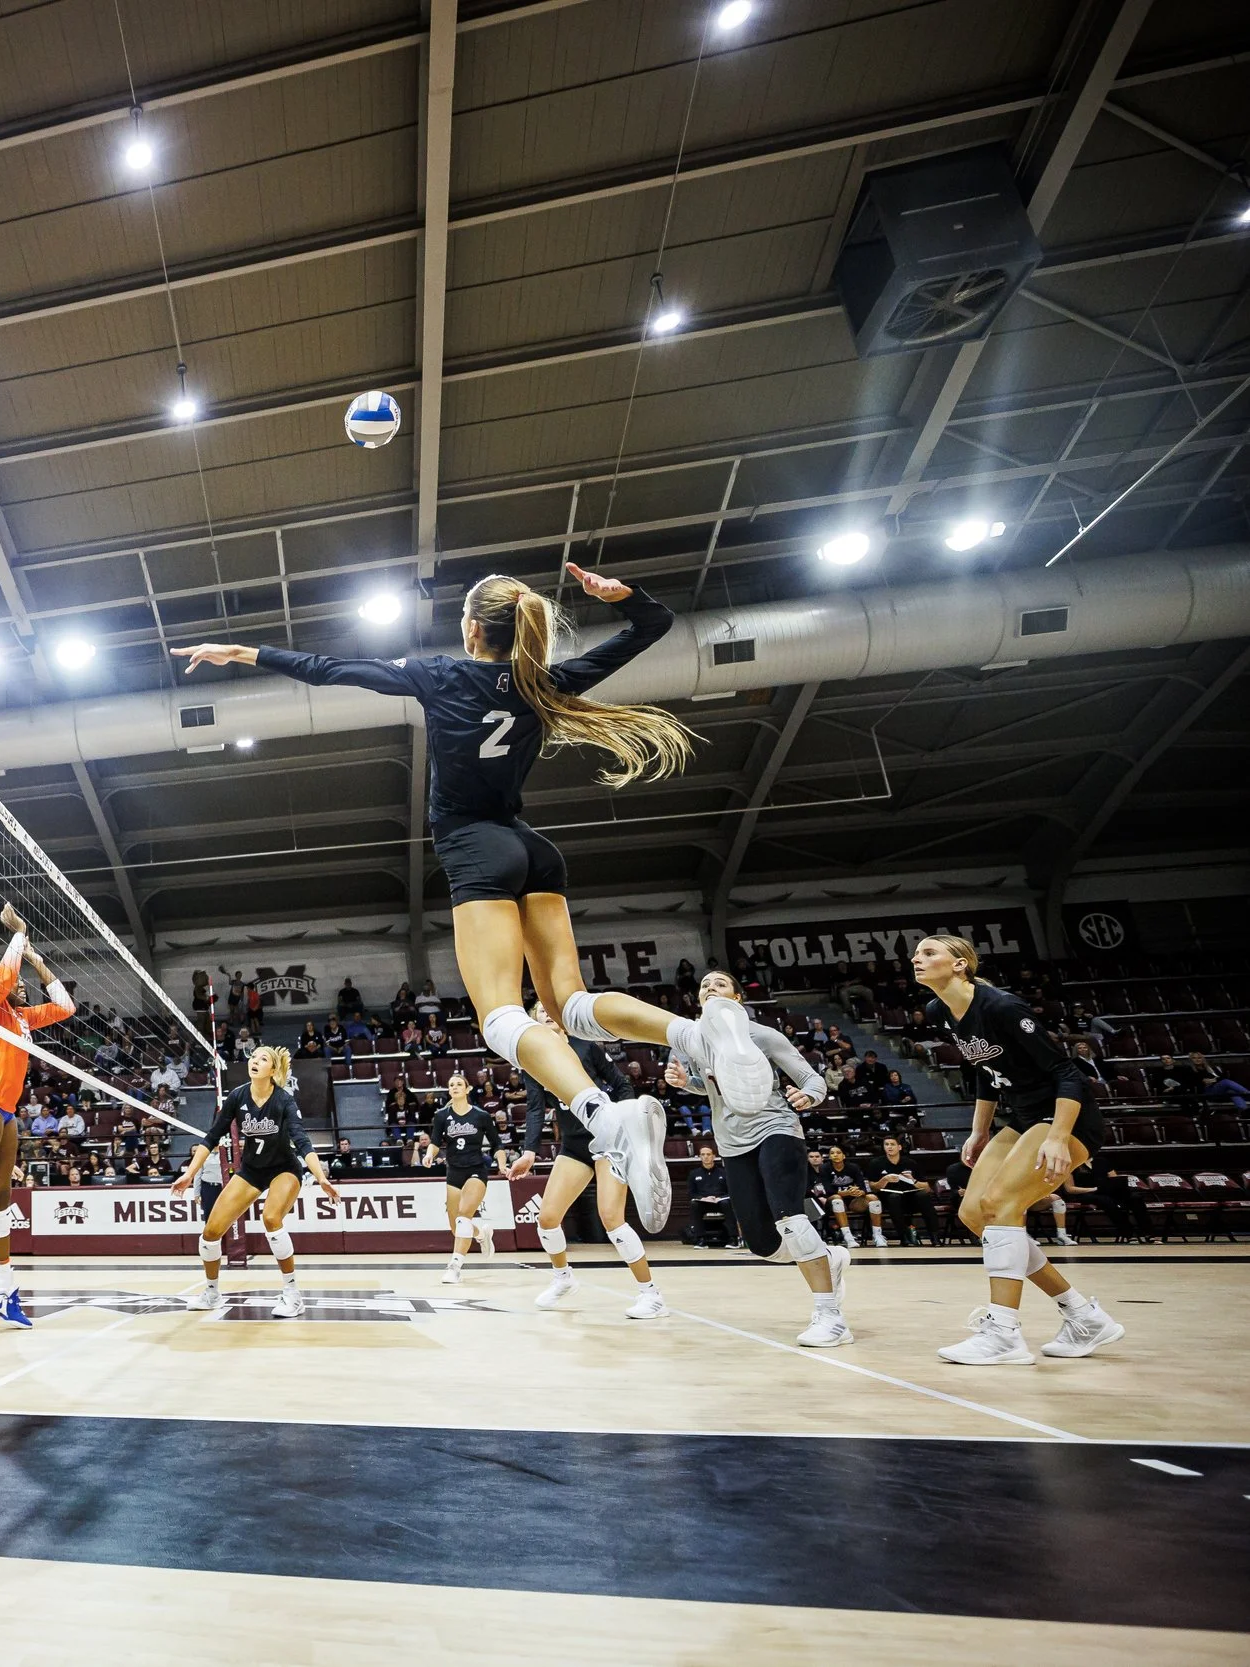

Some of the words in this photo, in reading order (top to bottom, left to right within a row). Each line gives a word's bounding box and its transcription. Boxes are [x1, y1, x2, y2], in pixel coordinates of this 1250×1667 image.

[479, 710, 516, 758] 2
[1079, 913, 1124, 949] SEC
[739, 924, 1020, 968] VOLLEYLL
[260, 978, 304, 992] STATE
[241, 1112, 279, 1136] State
[254, 1138, 265, 1155] 7
[456, 1137, 466, 1150] 9
[60, 1208, 83, 1216] STATE
[114, 1197, 305, 1223] MISSIPI
[316, 1195, 417, 1220] STATE
[515, 1211, 540, 1224] adi
[9, 1218, 31, 1230] das
